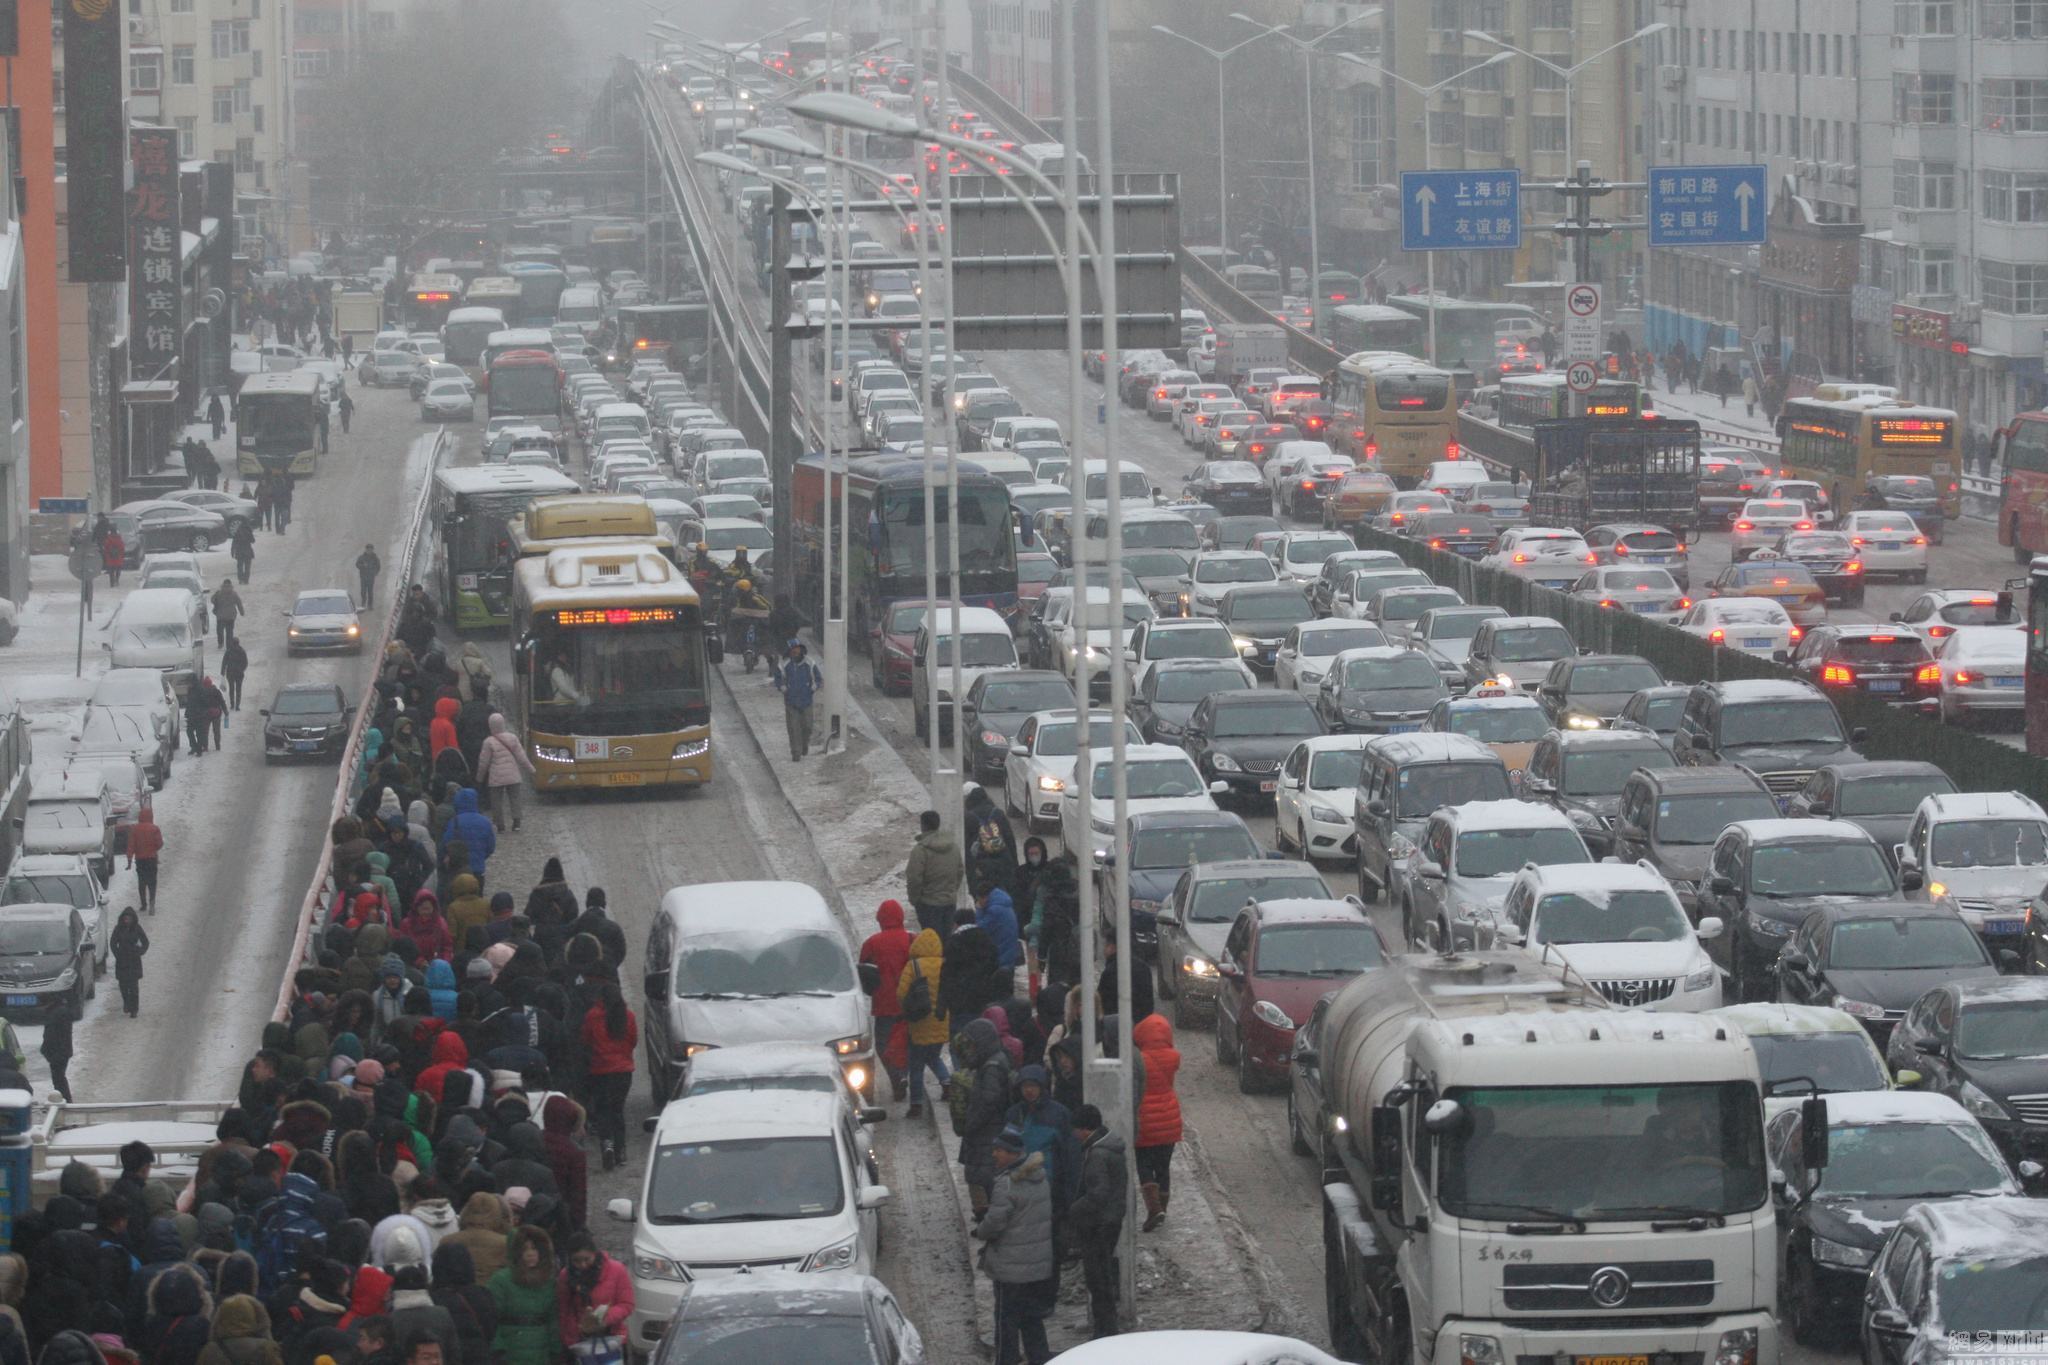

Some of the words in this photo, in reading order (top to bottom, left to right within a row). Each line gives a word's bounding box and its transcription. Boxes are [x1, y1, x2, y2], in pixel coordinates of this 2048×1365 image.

[1455, 181, 1512, 198] 上海街
[1659, 177, 1717, 194] 新阳路
[1455, 218, 1512, 234] 友谊路
[1660, 211, 1718, 228] 安国街
[584, 742, 599, 754] 348
